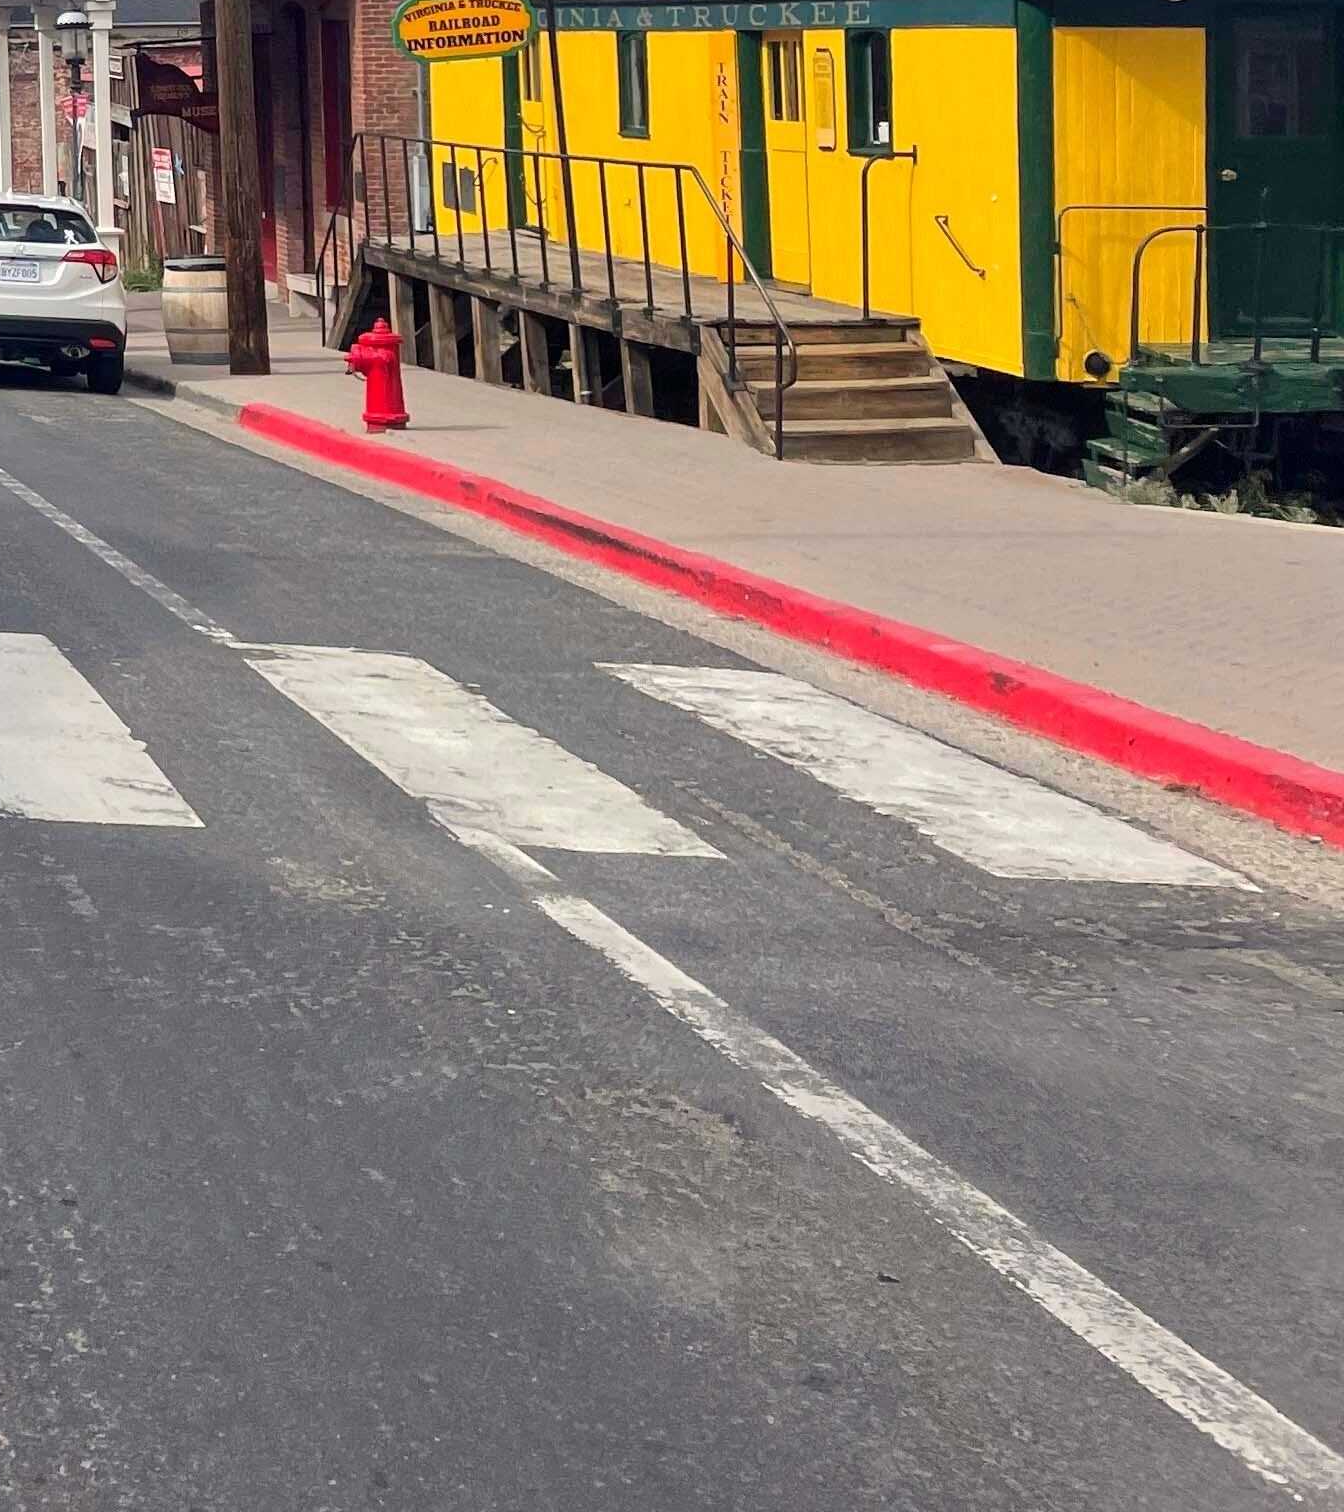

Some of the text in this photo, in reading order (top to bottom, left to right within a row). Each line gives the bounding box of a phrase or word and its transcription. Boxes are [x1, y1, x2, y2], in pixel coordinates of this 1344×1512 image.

[403, 0, 456, 23] VIRGINIA
[537, 0, 871, 28] GINIA & TRUCKEE
[427, 14, 501, 33] RAILROAD
[406, 29, 526, 53] INFORMATION
[716, 61, 730, 125] TRAIN
[181, 105, 217, 118] MUSE
